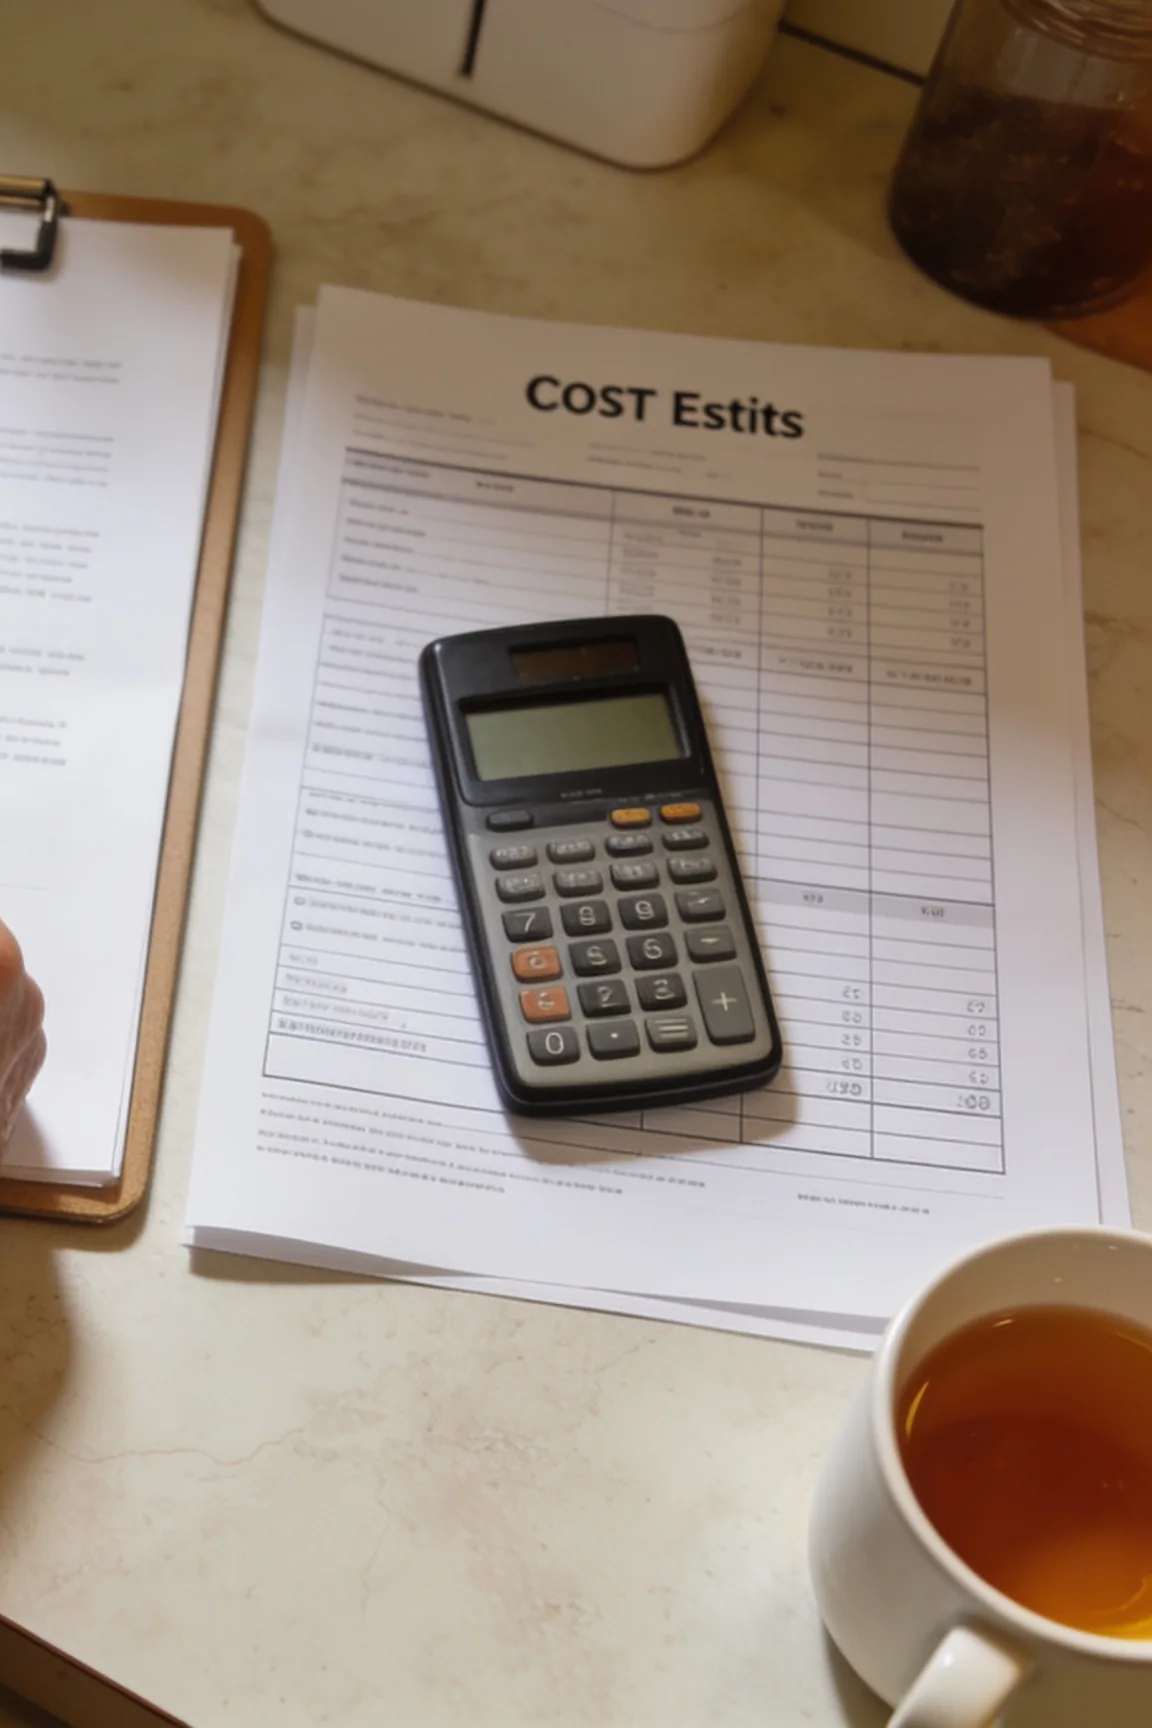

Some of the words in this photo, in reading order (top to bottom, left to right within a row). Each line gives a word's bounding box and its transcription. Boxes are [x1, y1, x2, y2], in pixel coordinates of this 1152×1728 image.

[525, 375, 658, 422] COST
[672, 390, 805, 439] Estits
[515, 912, 536, 932] 7
